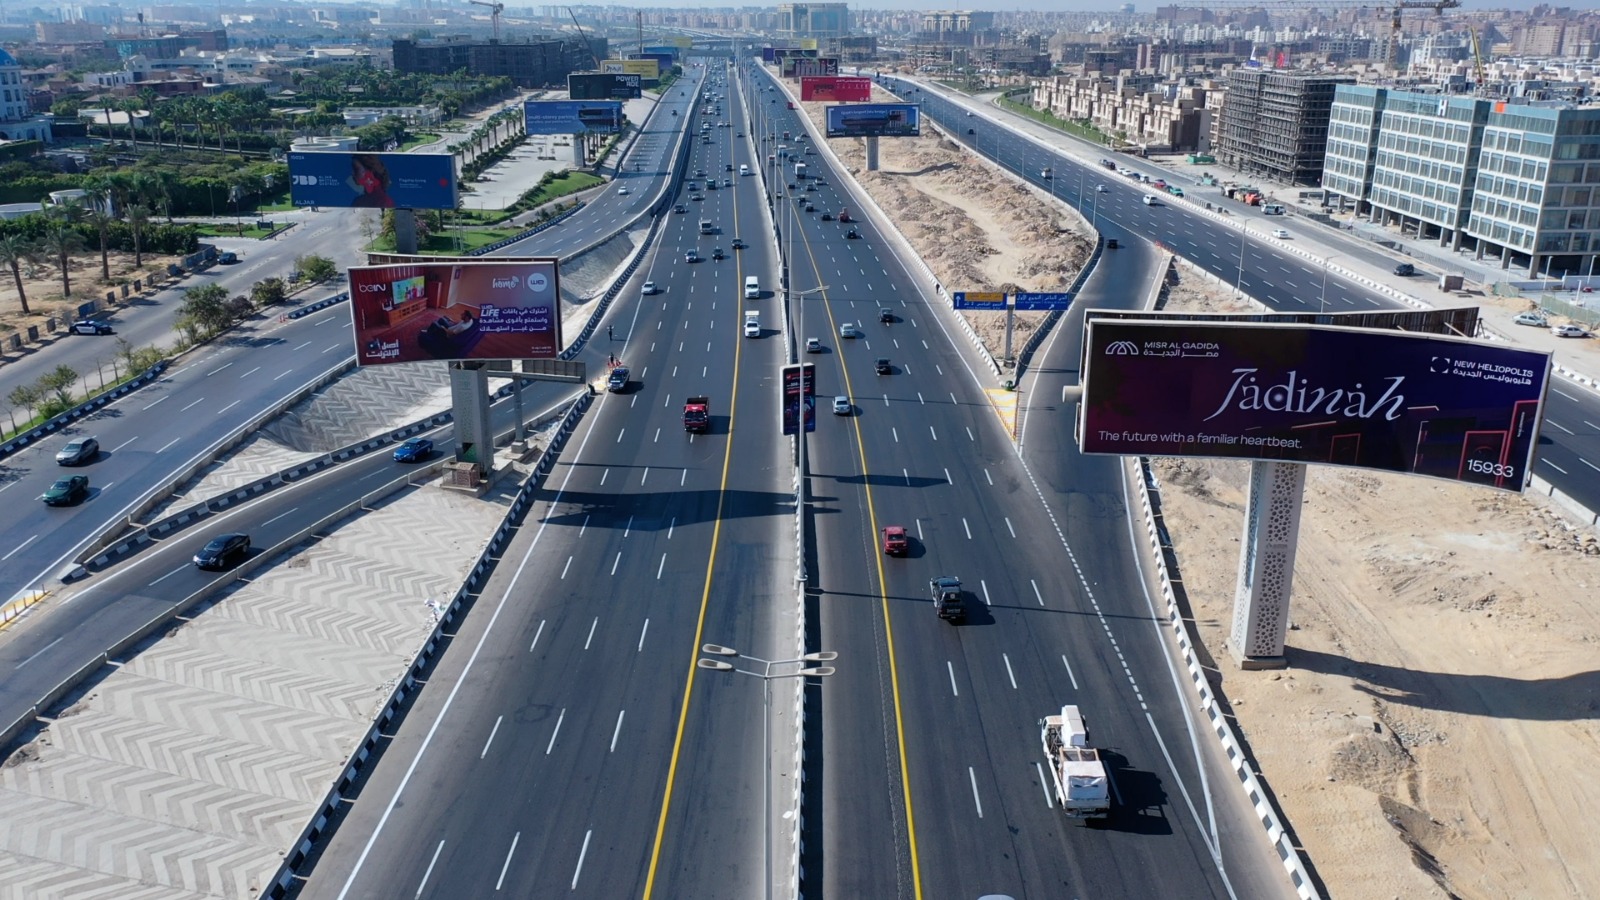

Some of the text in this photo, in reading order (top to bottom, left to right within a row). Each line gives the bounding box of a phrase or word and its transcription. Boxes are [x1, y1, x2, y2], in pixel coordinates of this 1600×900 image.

[292, 175, 318, 185] JBD
[492, 278, 517, 290] home
[1143, 349, 1180, 357] الجديدة
[1453, 368, 1482, 379] الجديدة
[1454, 360, 1533, 378] NEW HELIOPOLIS
[1098, 431, 1120, 441] The
[1122, 431, 1157, 442] future
[1160, 432, 1185, 443] with
[1197, 433, 1238, 445] familiar
[1240, 435, 1302, 448] heartbeat.
[1467, 459, 1514, 478] 15933
